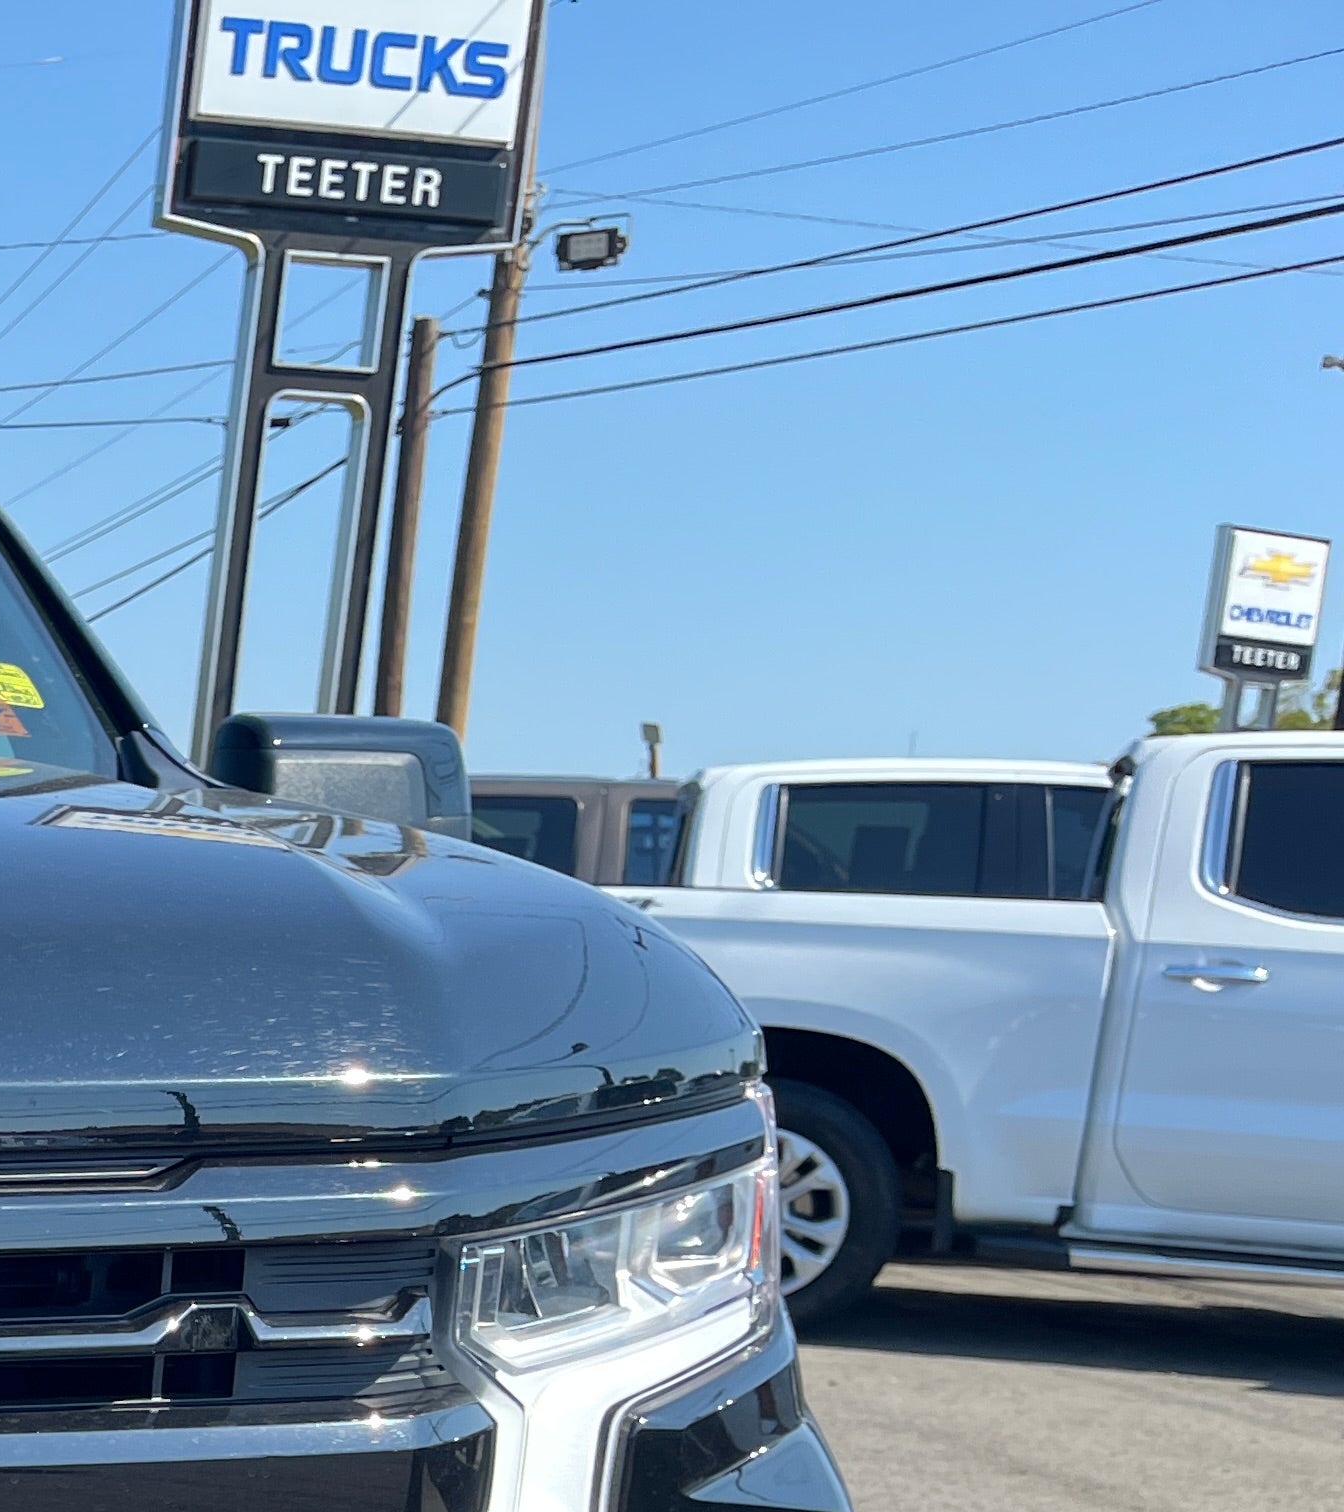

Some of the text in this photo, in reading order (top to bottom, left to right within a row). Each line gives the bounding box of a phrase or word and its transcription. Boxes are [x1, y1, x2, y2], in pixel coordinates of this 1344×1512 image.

[221, 16, 509, 99] TRUCKS
[257, 152, 443, 207] TEETER
[1232, 644, 1301, 671] TEETER
